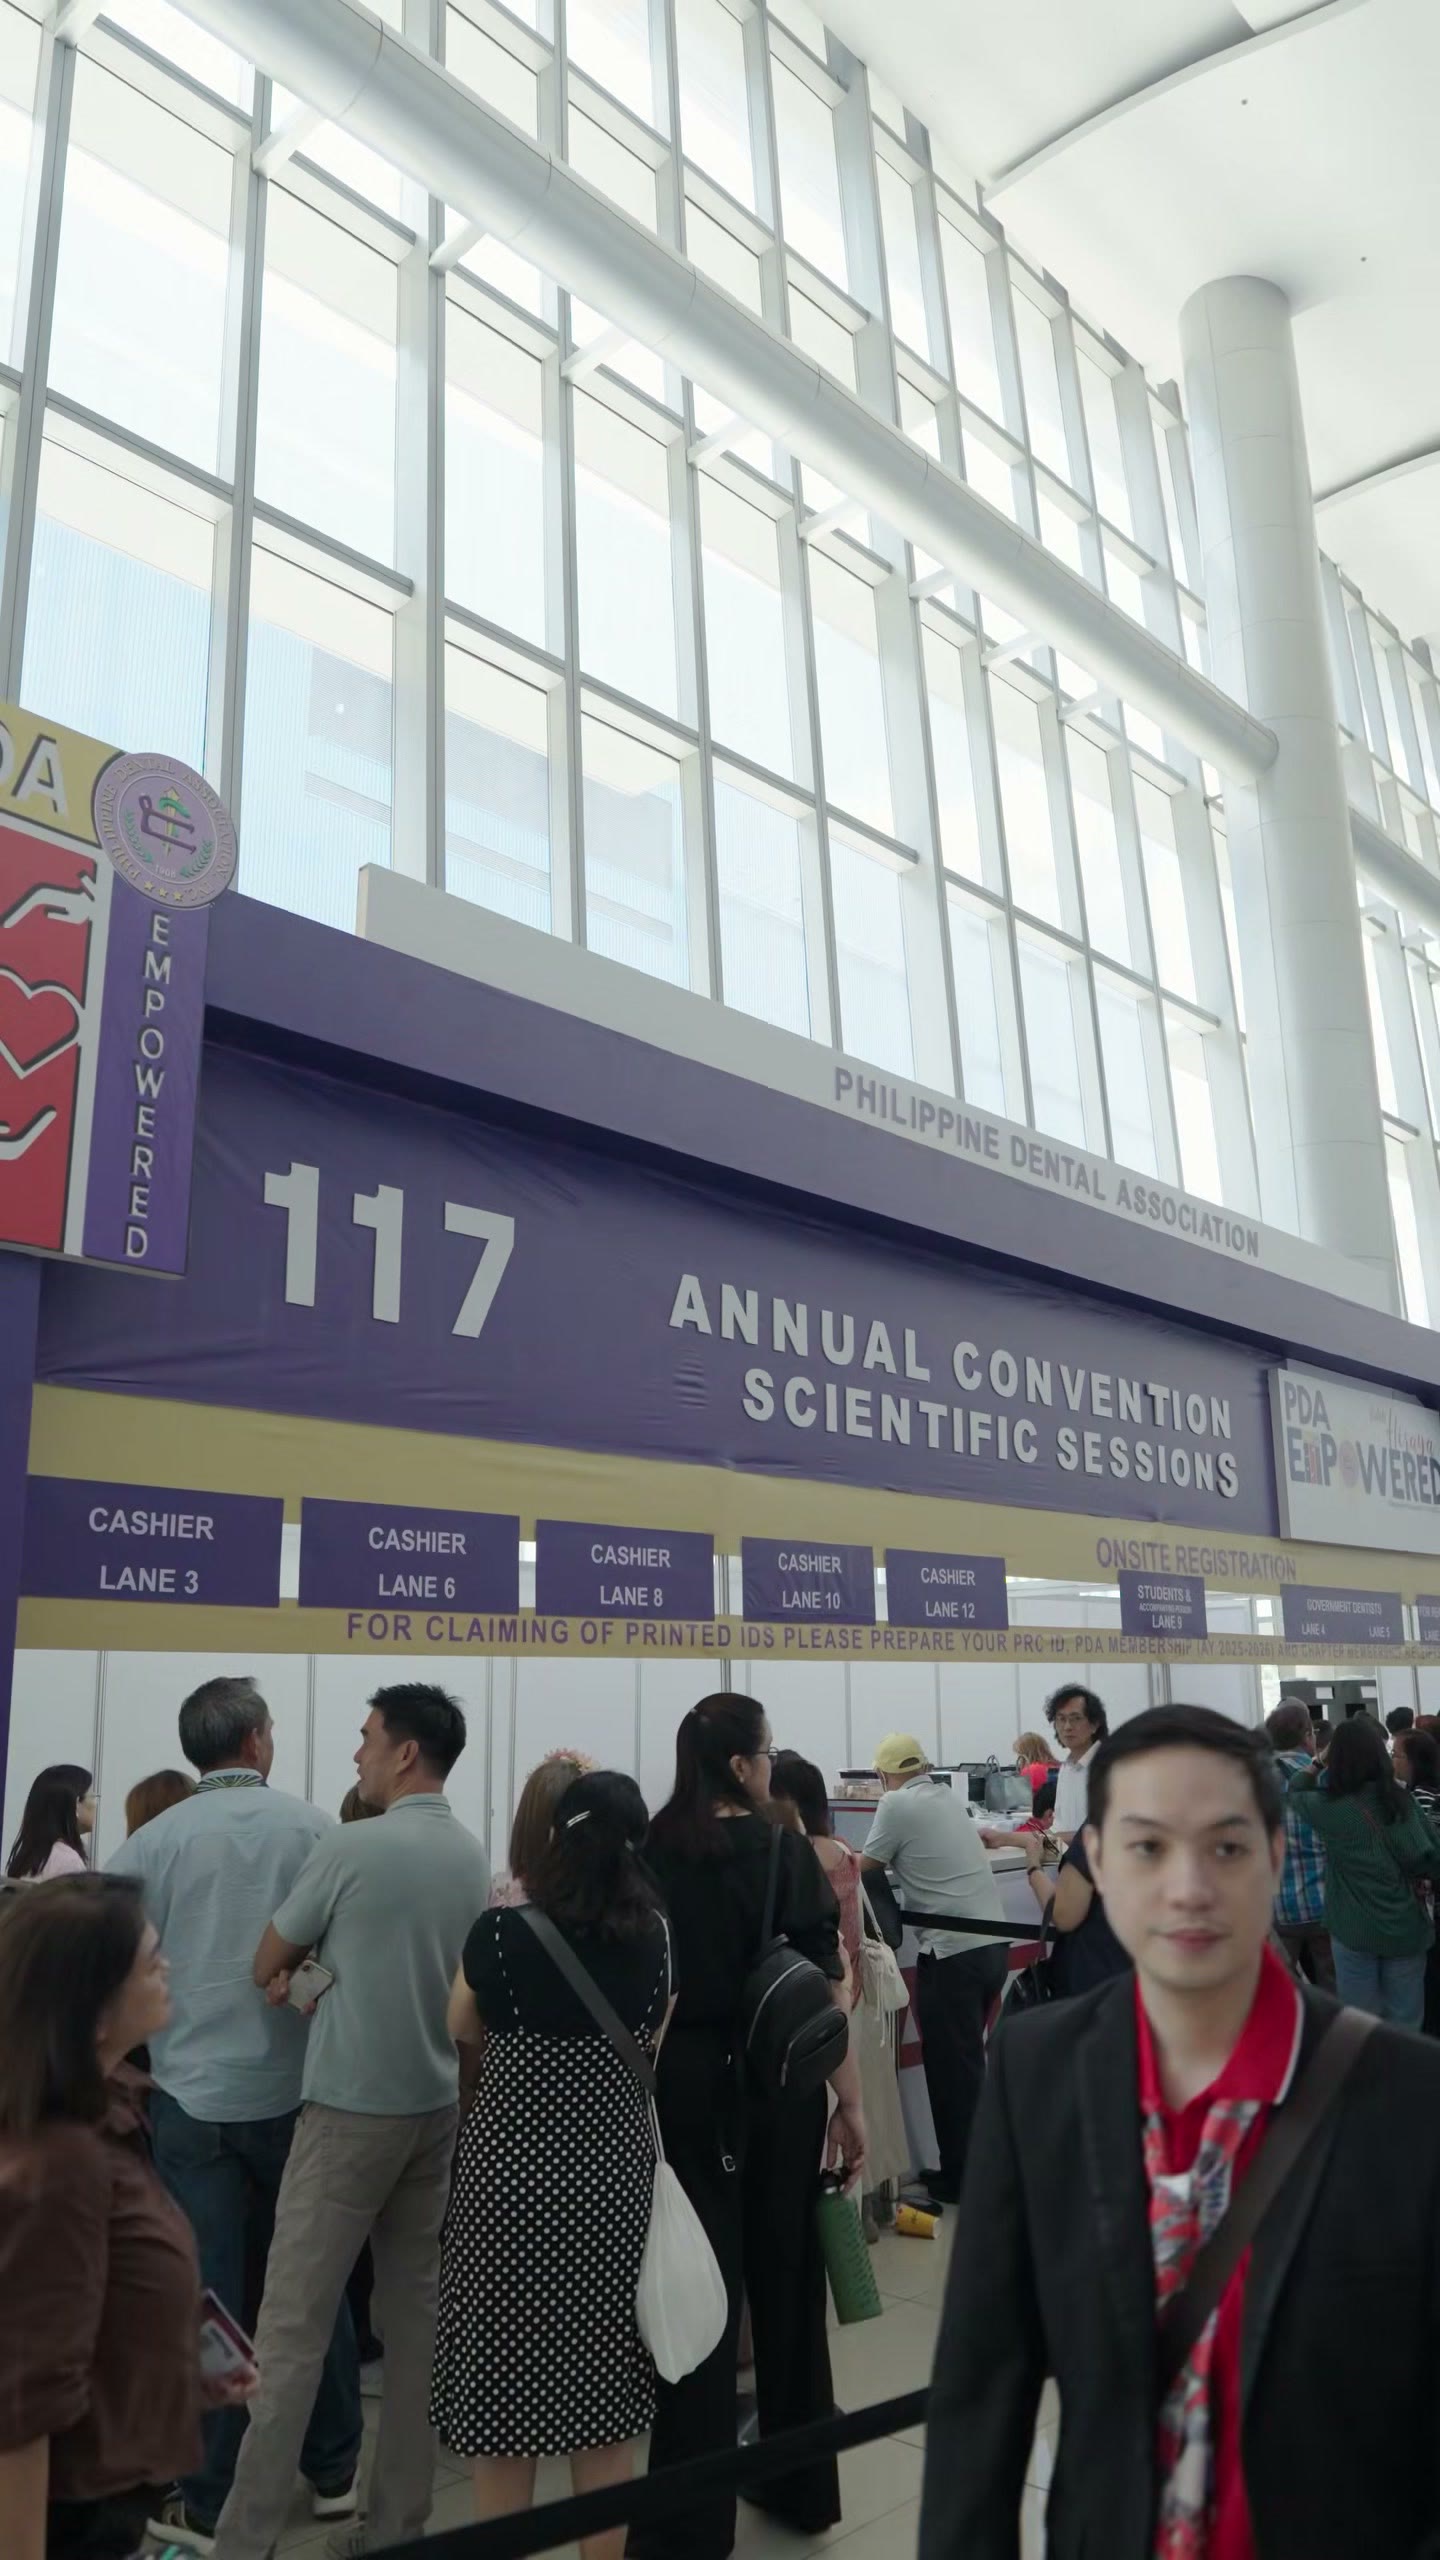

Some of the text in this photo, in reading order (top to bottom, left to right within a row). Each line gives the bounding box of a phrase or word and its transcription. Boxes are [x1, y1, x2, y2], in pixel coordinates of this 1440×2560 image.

[125, 912, 172, 1259] EMPOWERED
[834, 1066, 1259, 1258] PHILIPPINE DENTAL ASSOCIATION
[264, 1161, 515, 1339] 117
[669, 1273, 1232, 1440] ANNUAL CONVENTION
[1284, 1380, 1332, 1432] PDA
[742, 1368, 1240, 1498] SCIENTIFIC SESSIONS
[88, 1507, 215, 1541] CASHIER
[368, 1526, 467, 1555] CASHIER
[590, 1543, 672, 1569] CASHIER
[777, 1551, 843, 1575] CASHIER
[1096, 1537, 1297, 1581] ONSITE REGISTRATION
[100, 1565, 200, 1595] LANE 3
[378, 1573, 457, 1600] LANE 6
[920, 1566, 977, 1587] CASHIER
[600, 1585, 664, 1608] LANE 8
[782, 1590, 841, 1611] LANE 10
[1137, 1584, 1184, 1602] STUDENTS
[925, 1600, 976, 1620] LANE 12
[1306, 1599, 1382, 1615] GOVERNMENT DENTISTS
[347, 1612, 413, 1641] FOR
[425, 1615, 570, 1644] CLAIMING
[580, 1619, 614, 1645] OF
[626, 1622, 732, 1647] PRINTED
[741, 1625, 775, 1648] IDS
[784, 1626, 863, 1650] PLEASE
[871, 1629, 956, 1652] PREPARE
[962, 1632, 1007, 1652] YOUR
[1013, 1633, 1043, 1653] PRC
[1075, 1635, 1104, 1653] PDA
[1108, 1636, 1192, 1655] MEMBERSHIP
[1151, 1614, 1183, 1630] LANE 9
[1302, 1624, 1319, 1636] LANE
[1369, 1626, 1385, 1638] LANE
